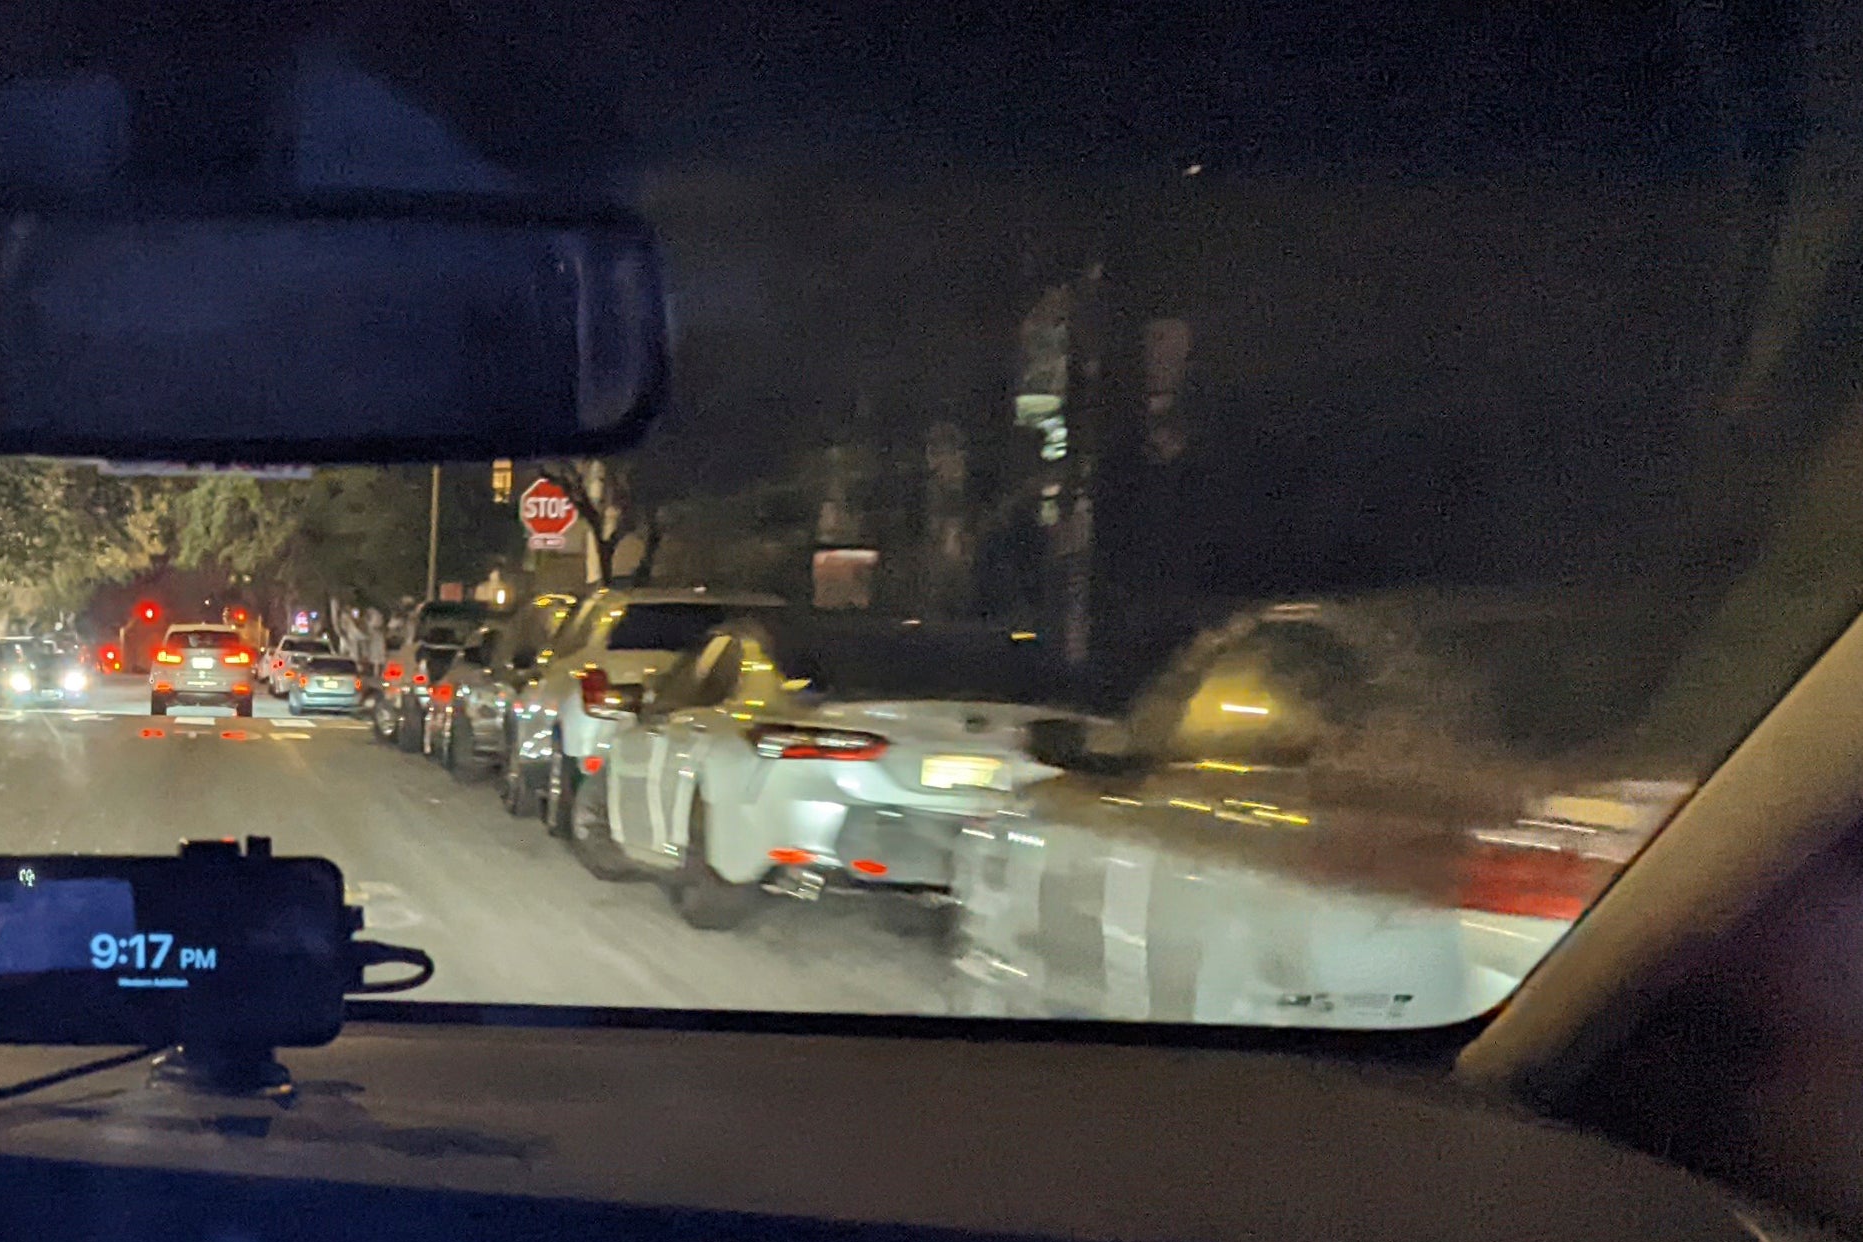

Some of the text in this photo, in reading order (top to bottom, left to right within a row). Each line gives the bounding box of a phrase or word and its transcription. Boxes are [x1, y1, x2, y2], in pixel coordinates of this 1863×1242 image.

[525, 497, 574, 518] STOP
[91, 933, 217, 969] 9:17 PM
